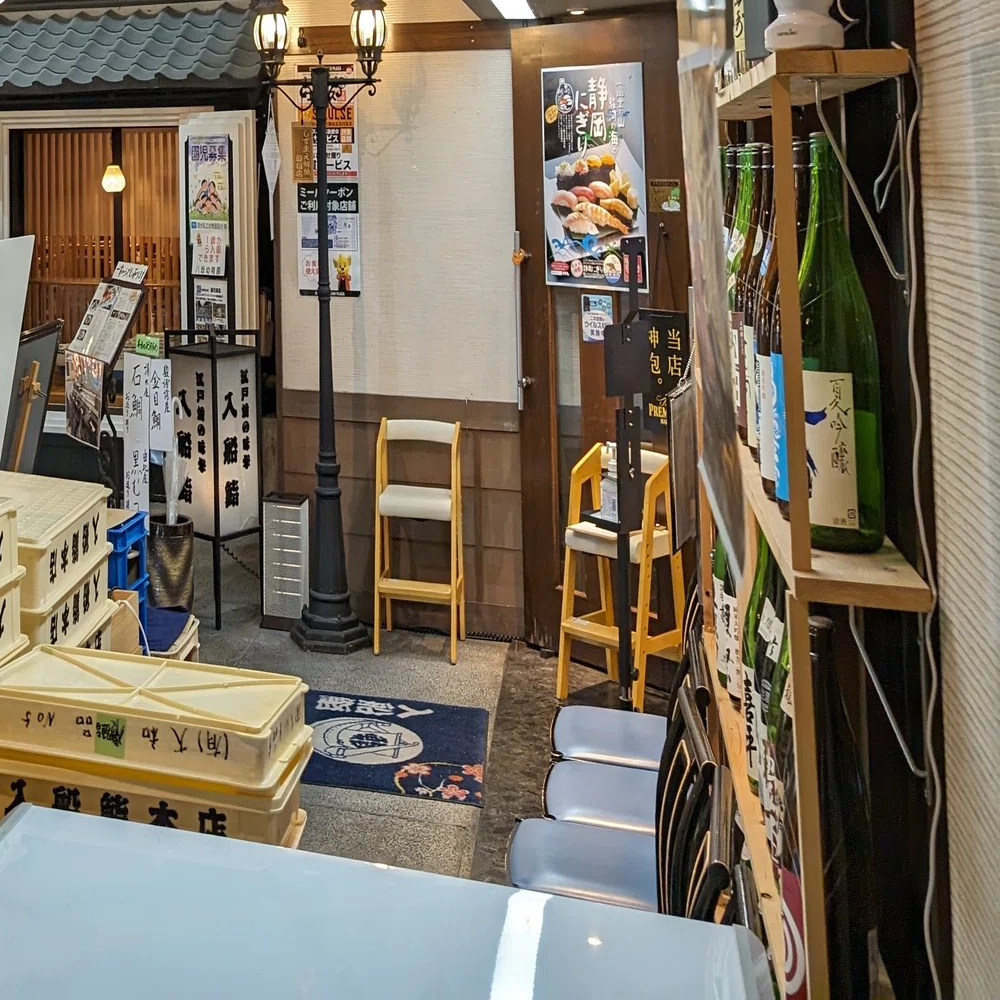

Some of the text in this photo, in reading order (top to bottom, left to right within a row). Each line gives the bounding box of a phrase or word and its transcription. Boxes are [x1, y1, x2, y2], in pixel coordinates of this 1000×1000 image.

[575, 90, 590, 158] にぎり
[588, 76, 608, 142] 静岡
[192, 145, 227, 161] 園児募集
[667, 328, 682, 377] 当店
[130, 364, 143, 421] 石鯛
[150, 370, 161, 431] 金目鯛
[222, 391, 240, 510] 入船鮨
[49, 511, 100, 585] 入船鮨本店
[49, 568, 101, 645] 入船鮨本店
